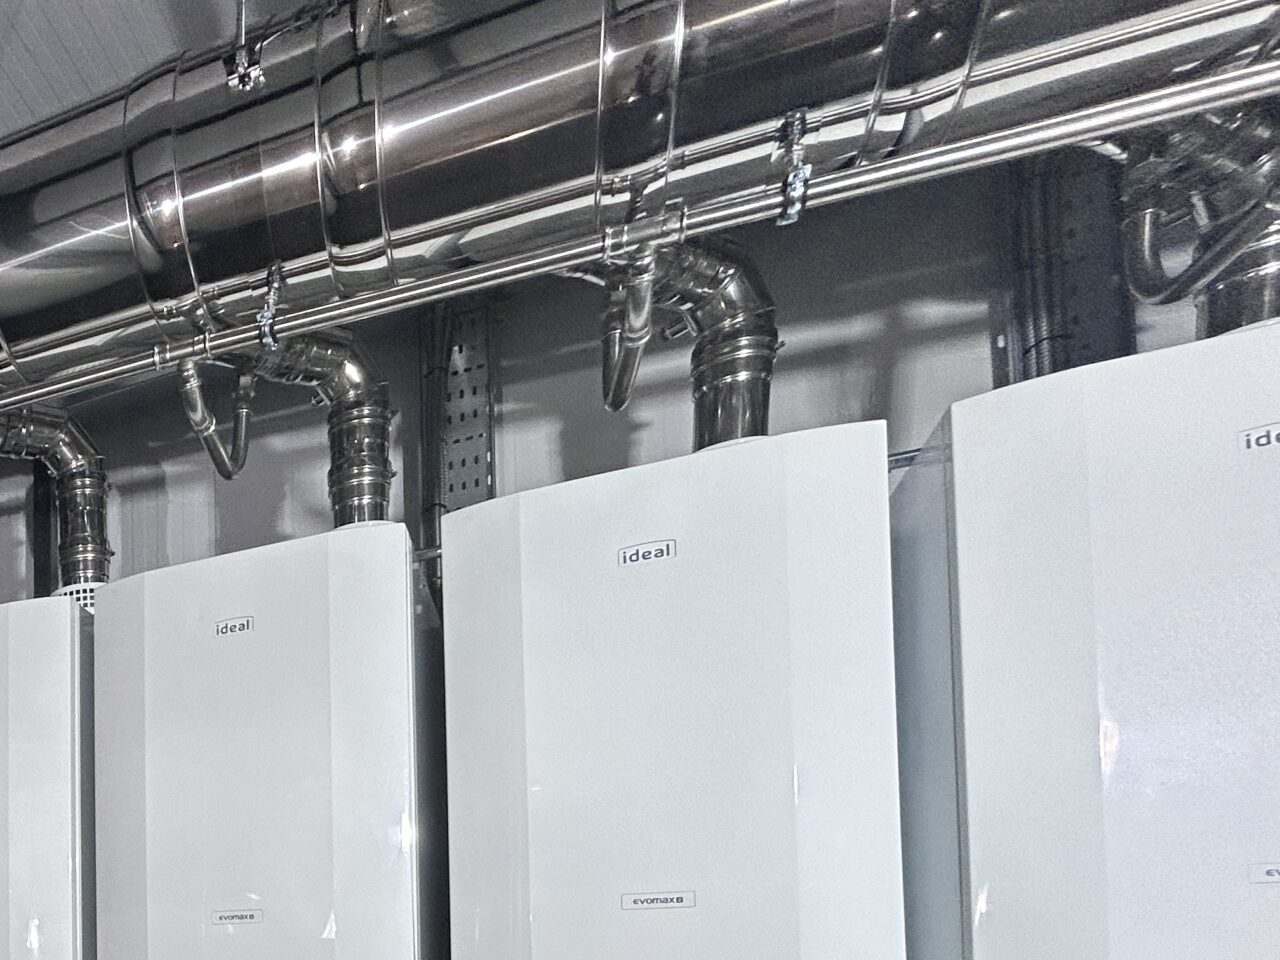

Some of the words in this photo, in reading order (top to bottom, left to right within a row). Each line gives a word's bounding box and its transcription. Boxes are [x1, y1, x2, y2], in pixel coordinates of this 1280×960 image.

[622, 543, 670, 564] ideal
[215, 619, 250, 636] ideal
[632, 896, 675, 905] evomax
